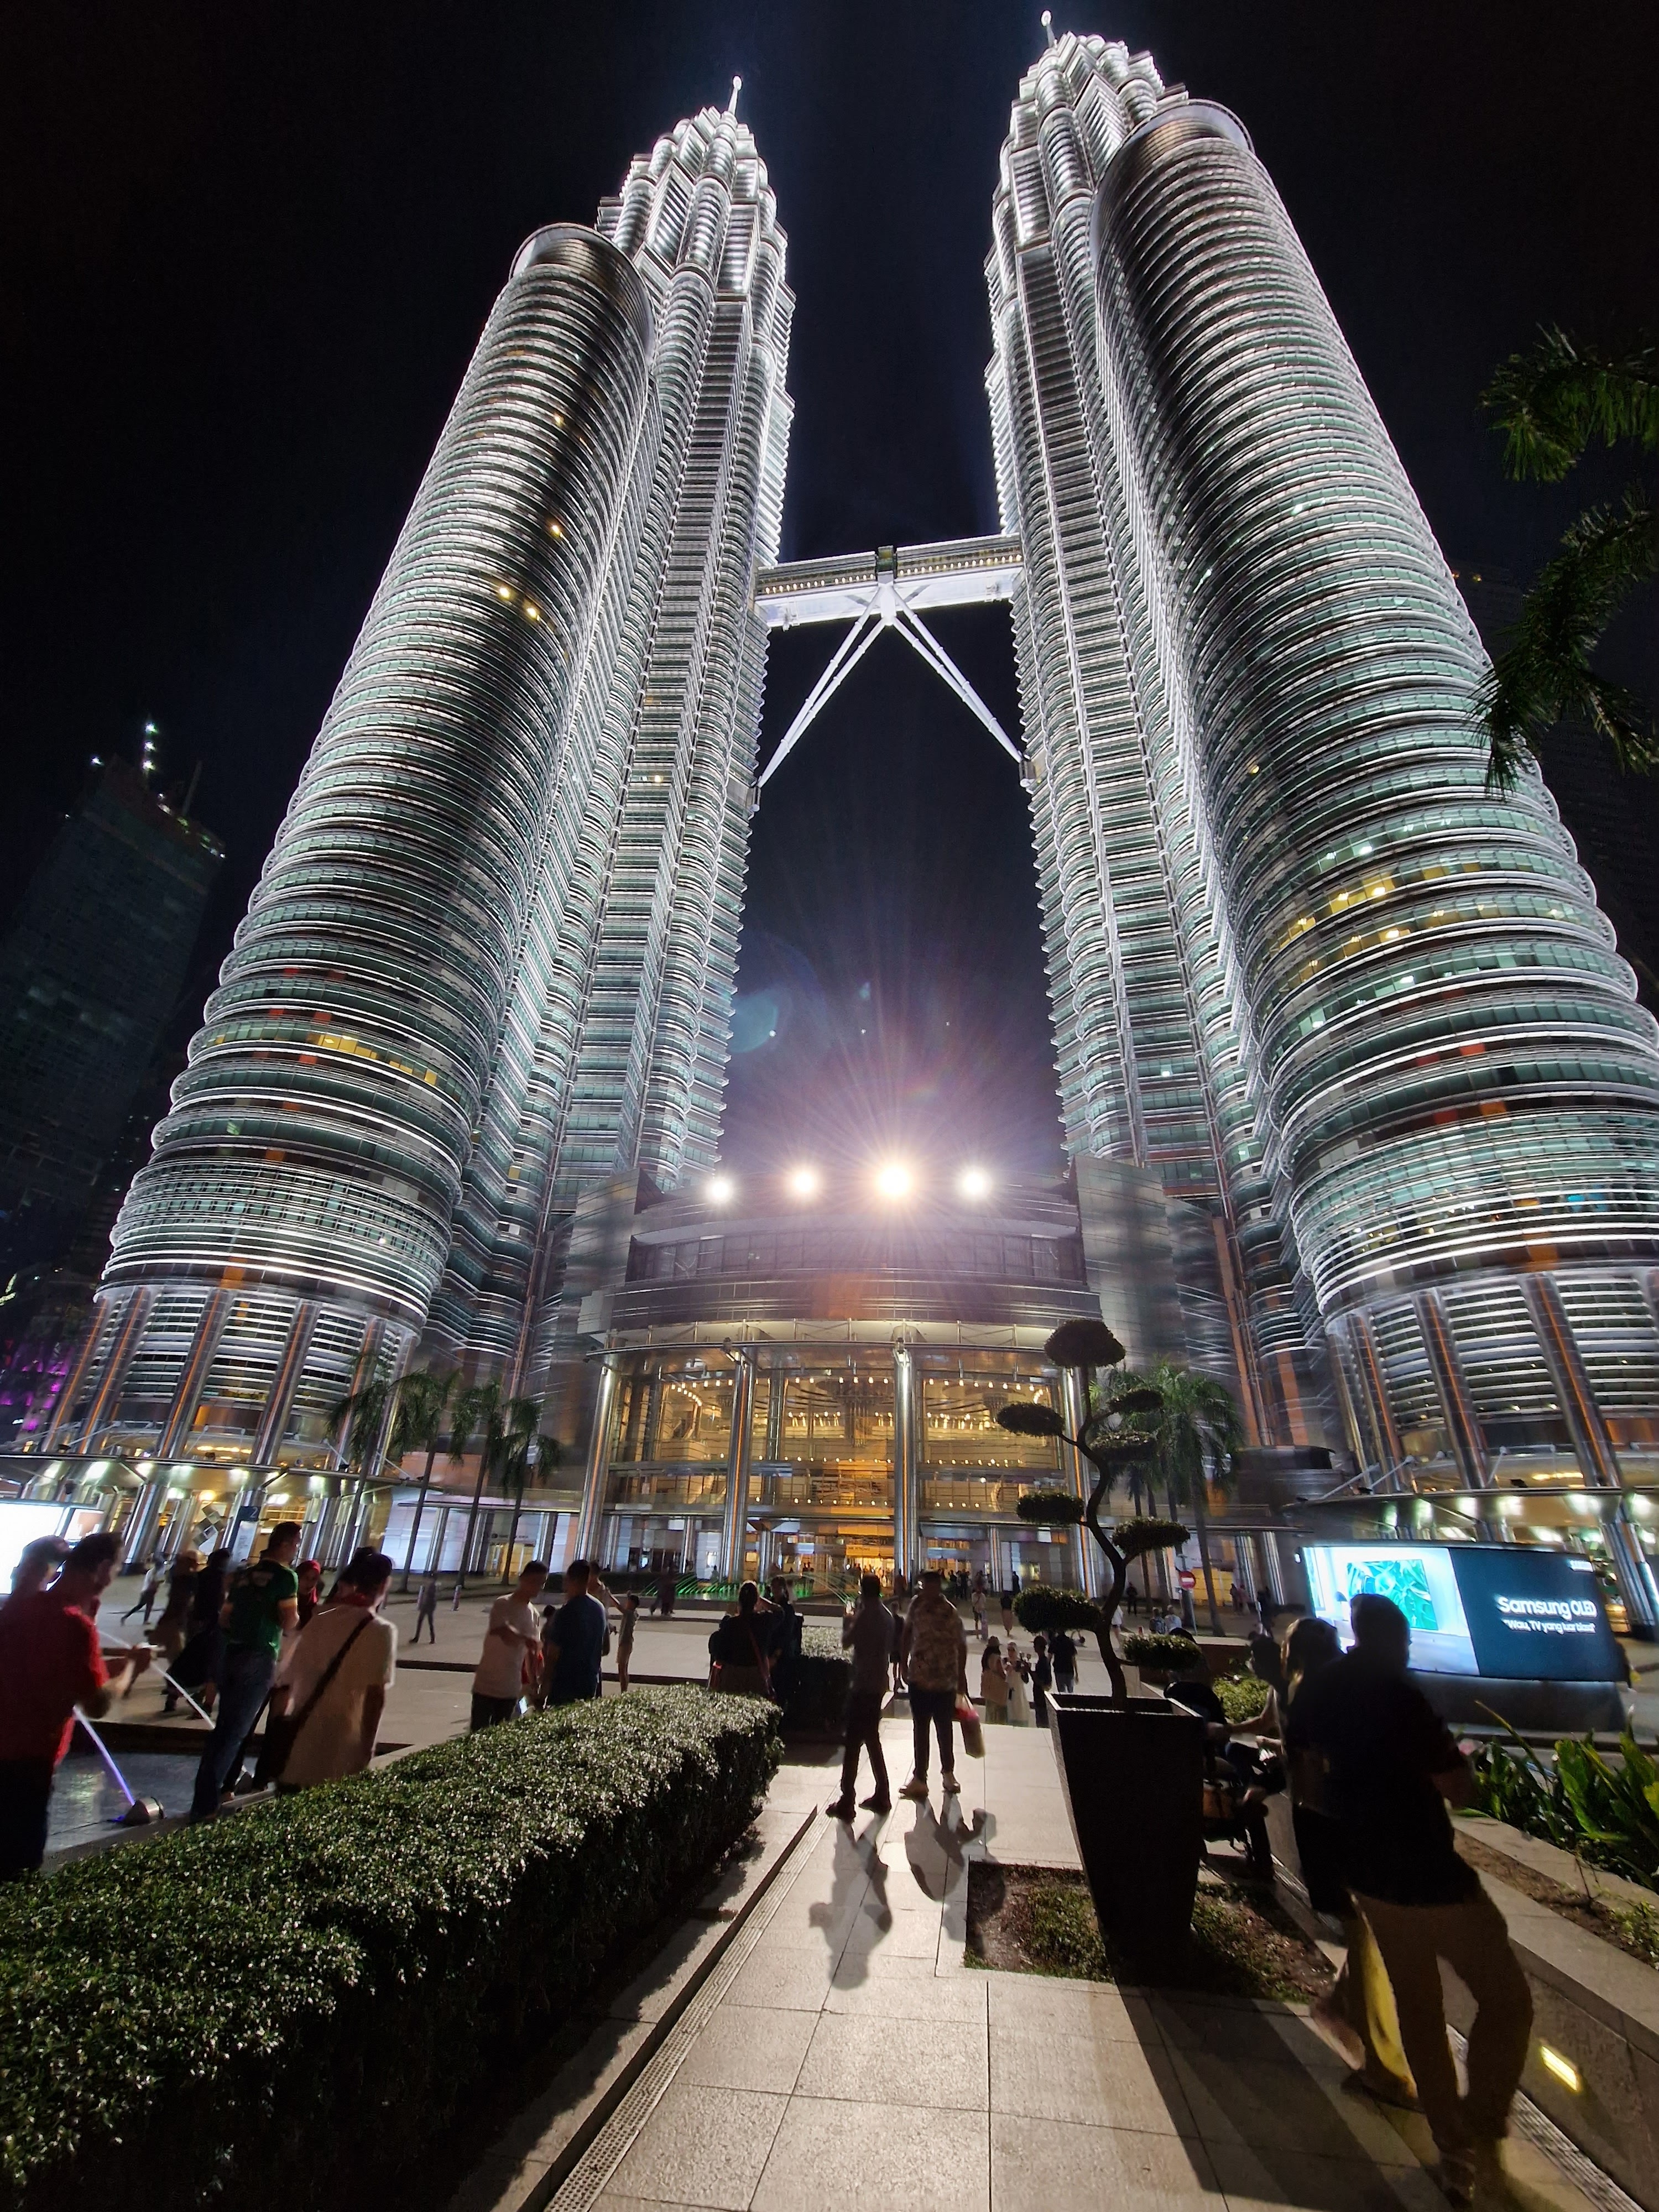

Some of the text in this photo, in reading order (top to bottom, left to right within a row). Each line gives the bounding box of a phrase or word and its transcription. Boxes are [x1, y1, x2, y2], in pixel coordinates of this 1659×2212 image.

[250, 1506, 259, 1519] 2
[1497, 1597, 1597, 1621] Samsung OLED
[1528, 1620, 1541, 1631] TV
[1541, 1623, 1564, 1635] yang
